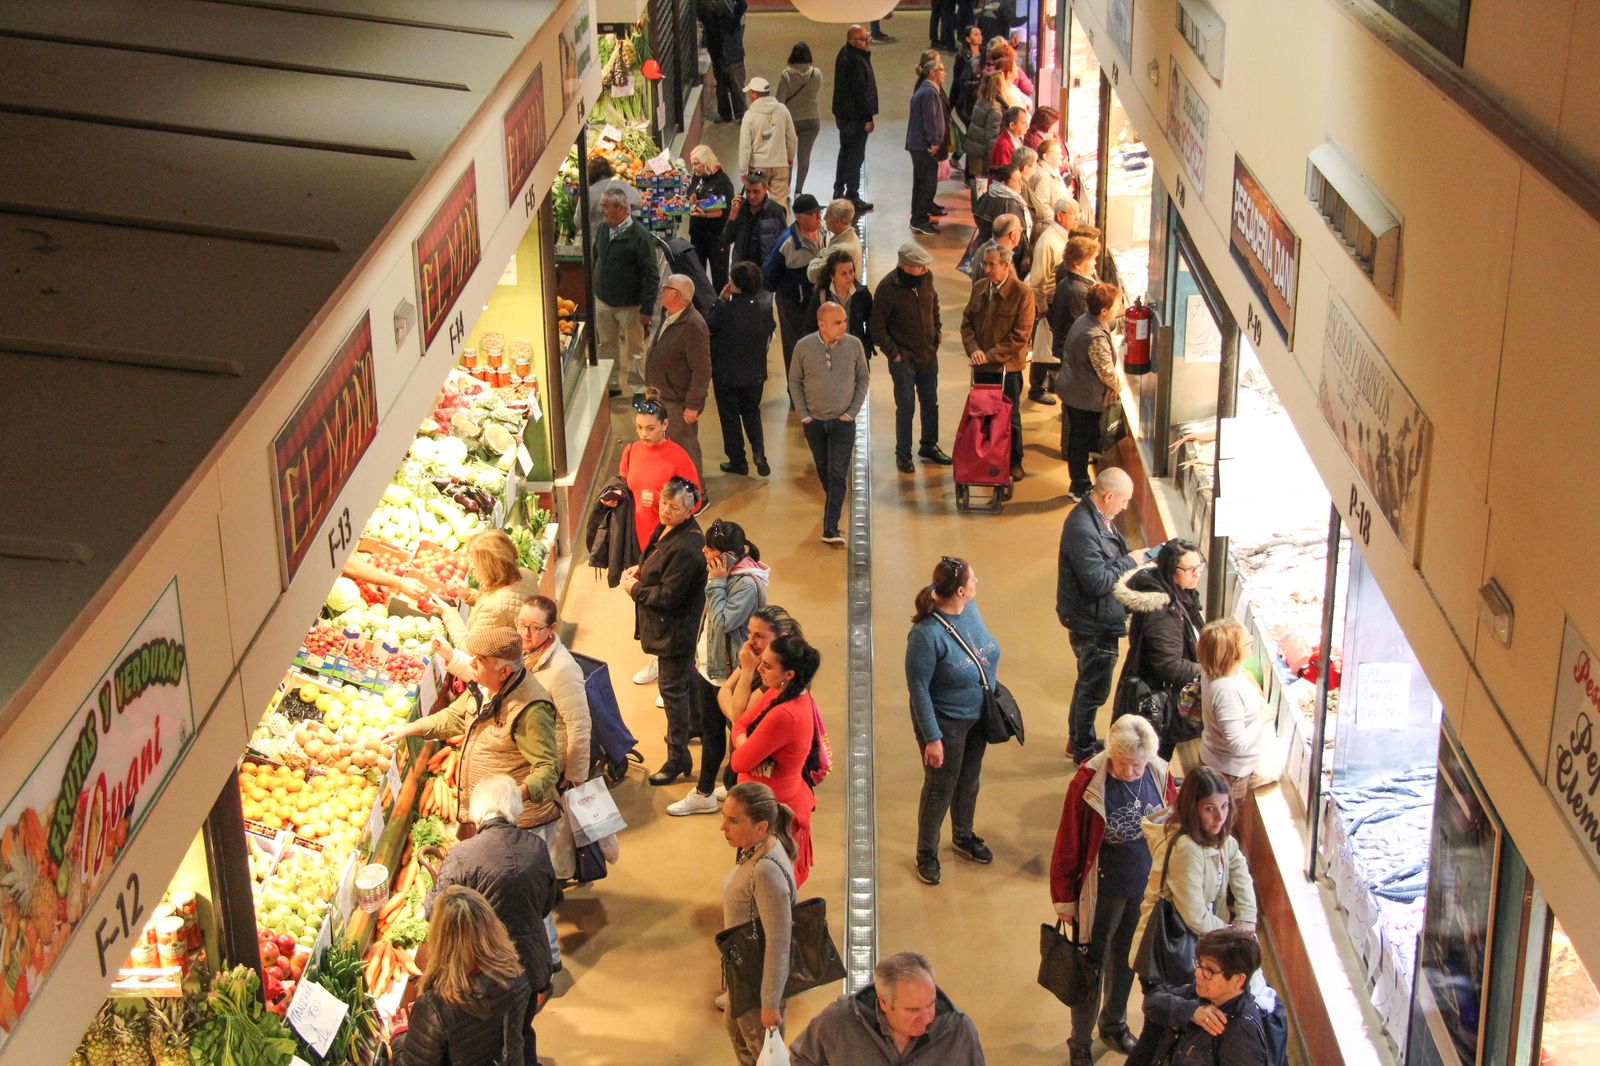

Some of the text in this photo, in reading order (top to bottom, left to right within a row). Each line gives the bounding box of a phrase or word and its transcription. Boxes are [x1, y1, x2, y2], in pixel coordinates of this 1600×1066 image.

[508, 128, 524, 191] EL
[423, 251, 447, 331] EL
[1274, 238, 1294, 310] DANI
[449, 311, 465, 355] F-14
[1247, 302, 1262, 347] P-19
[284, 350, 377, 553] EL MAÑO
[328, 506, 352, 568] F-13
[1349, 483, 1371, 548] P-18
[48, 637, 186, 867] FRUTAS Y VERDURAS
[94, 872, 144, 978] F-12
